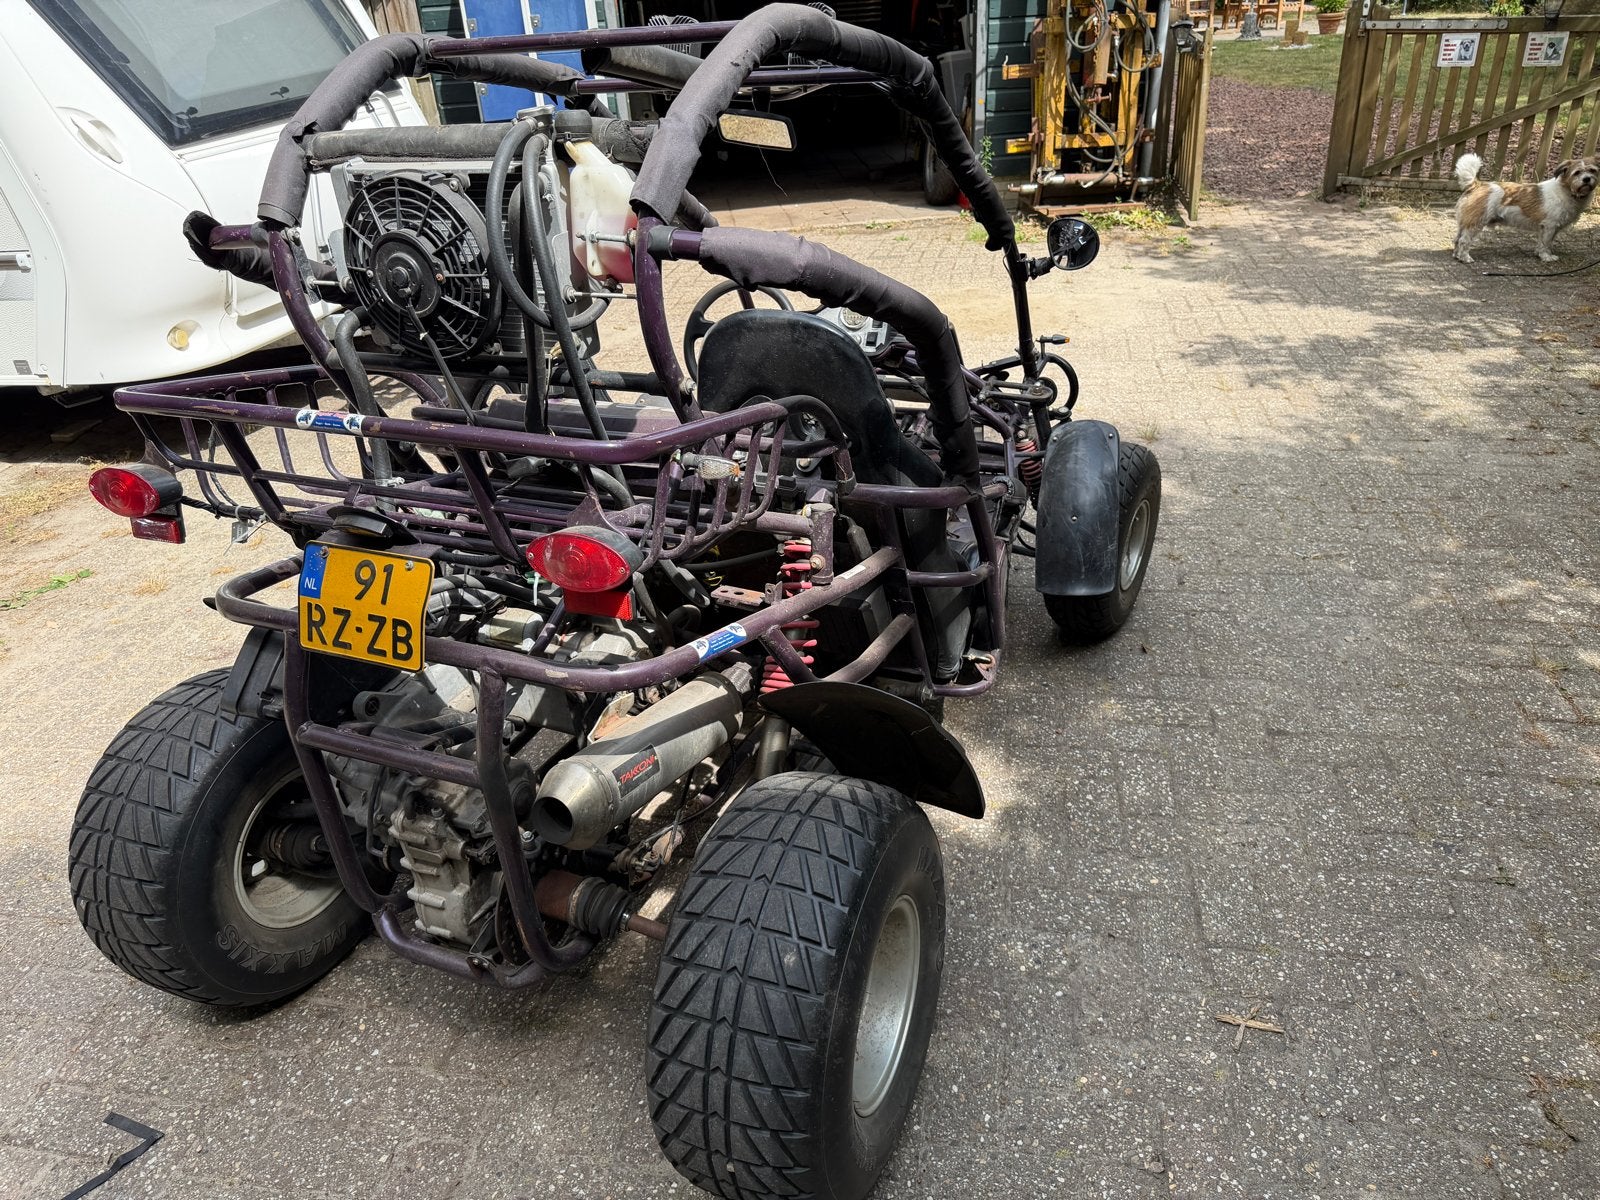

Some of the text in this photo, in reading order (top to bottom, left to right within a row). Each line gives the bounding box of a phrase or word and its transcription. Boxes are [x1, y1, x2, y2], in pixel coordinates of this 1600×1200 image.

[304, 576, 318, 591] NL
[354, 559, 394, 606] 91
[306, 601, 414, 662] RZ-ZB
[217, 921, 348, 975] MAXXIS
